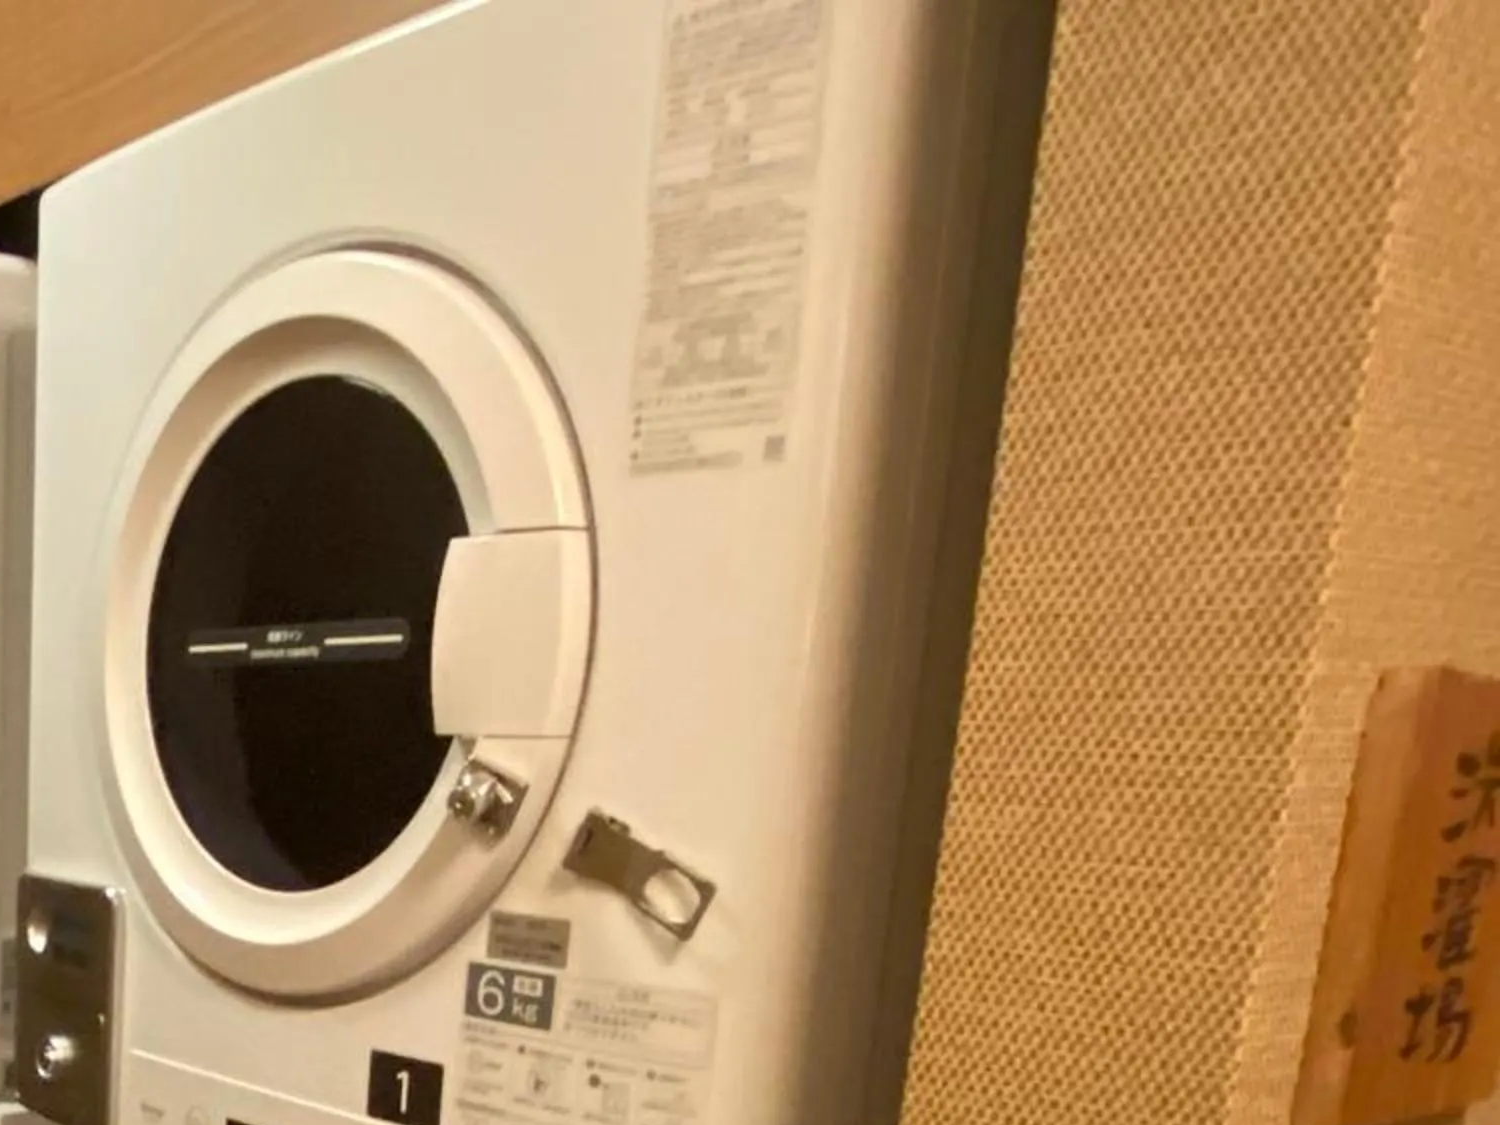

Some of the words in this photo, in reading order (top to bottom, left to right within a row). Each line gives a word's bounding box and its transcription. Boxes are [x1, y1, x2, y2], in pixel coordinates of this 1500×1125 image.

[477, 969, 506, 1016] 6
[511, 997, 540, 1024] kg
[396, 1070, 411, 1115] 1
